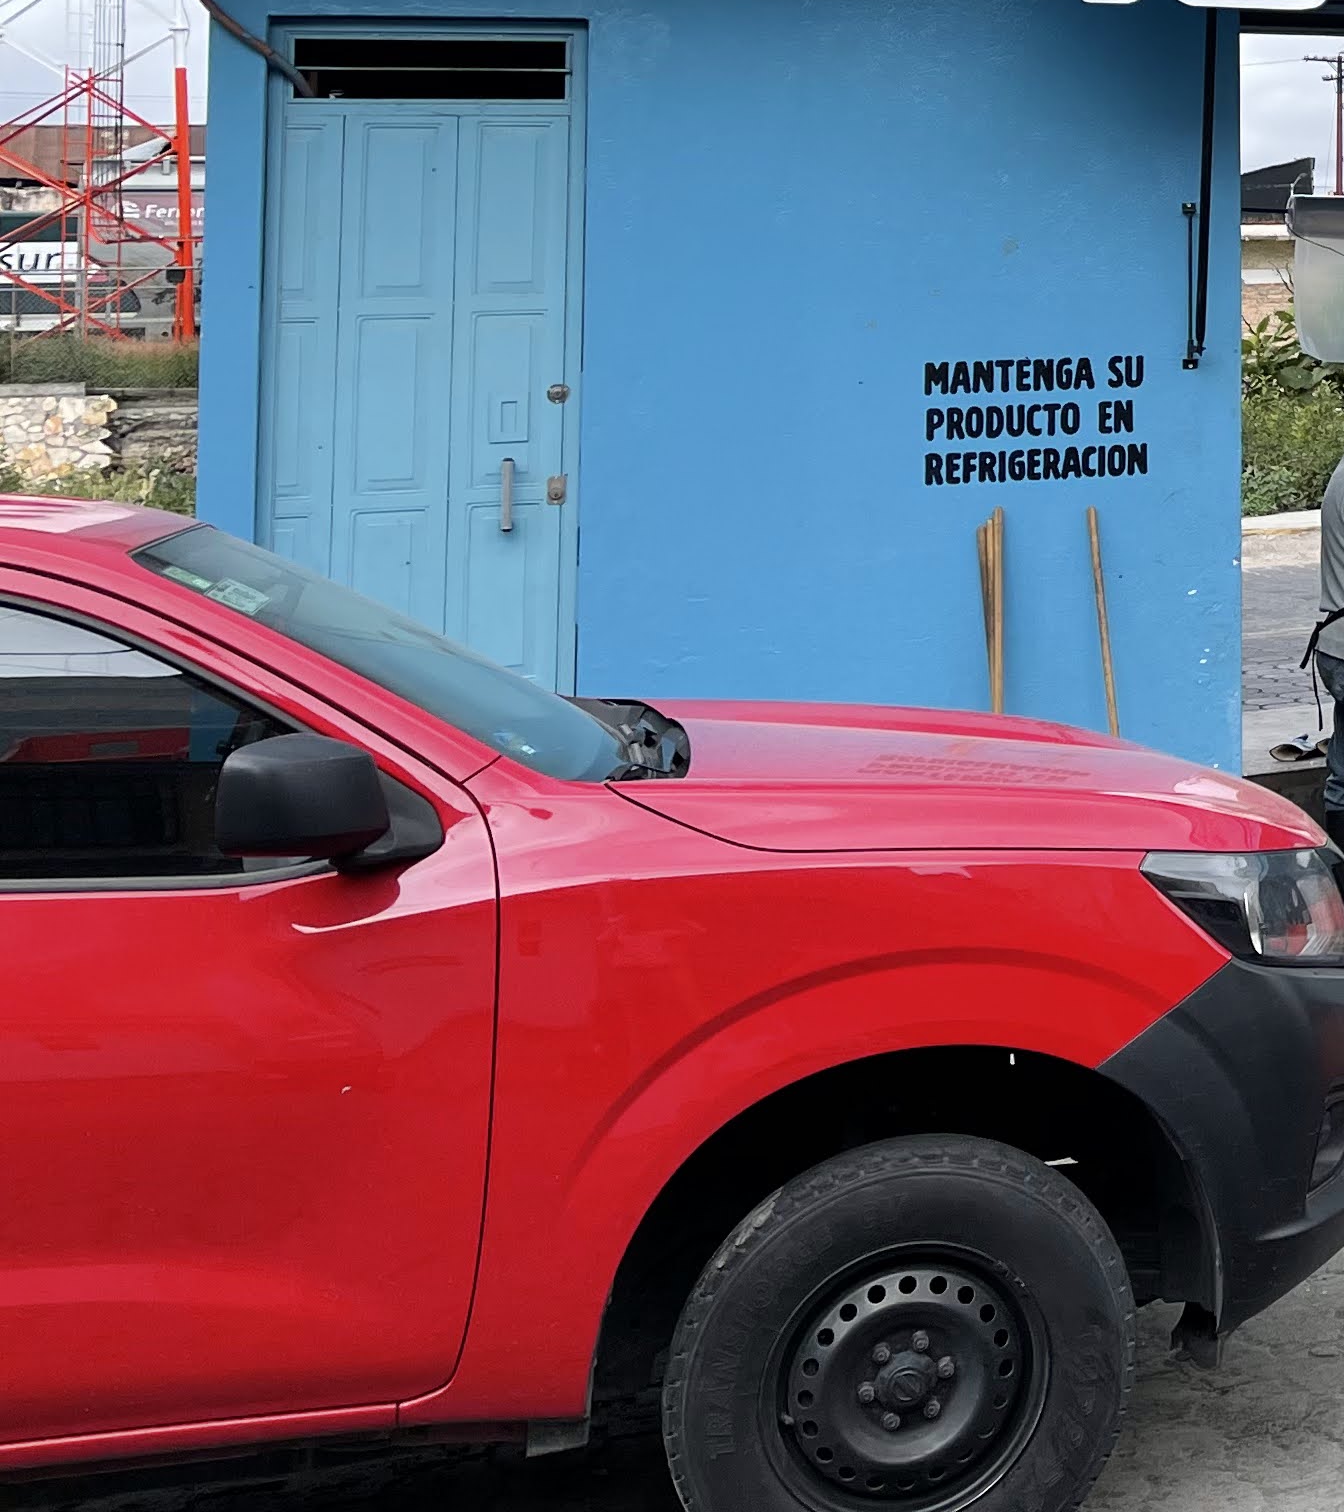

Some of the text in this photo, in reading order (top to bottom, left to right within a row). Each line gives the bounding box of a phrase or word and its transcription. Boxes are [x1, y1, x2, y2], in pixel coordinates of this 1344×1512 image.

[924, 355, 1144, 395] MANTENGA SU
[926, 399, 1134, 441] PRODUCTO EN
[924, 442, 1148, 486] REFRIGERACION
